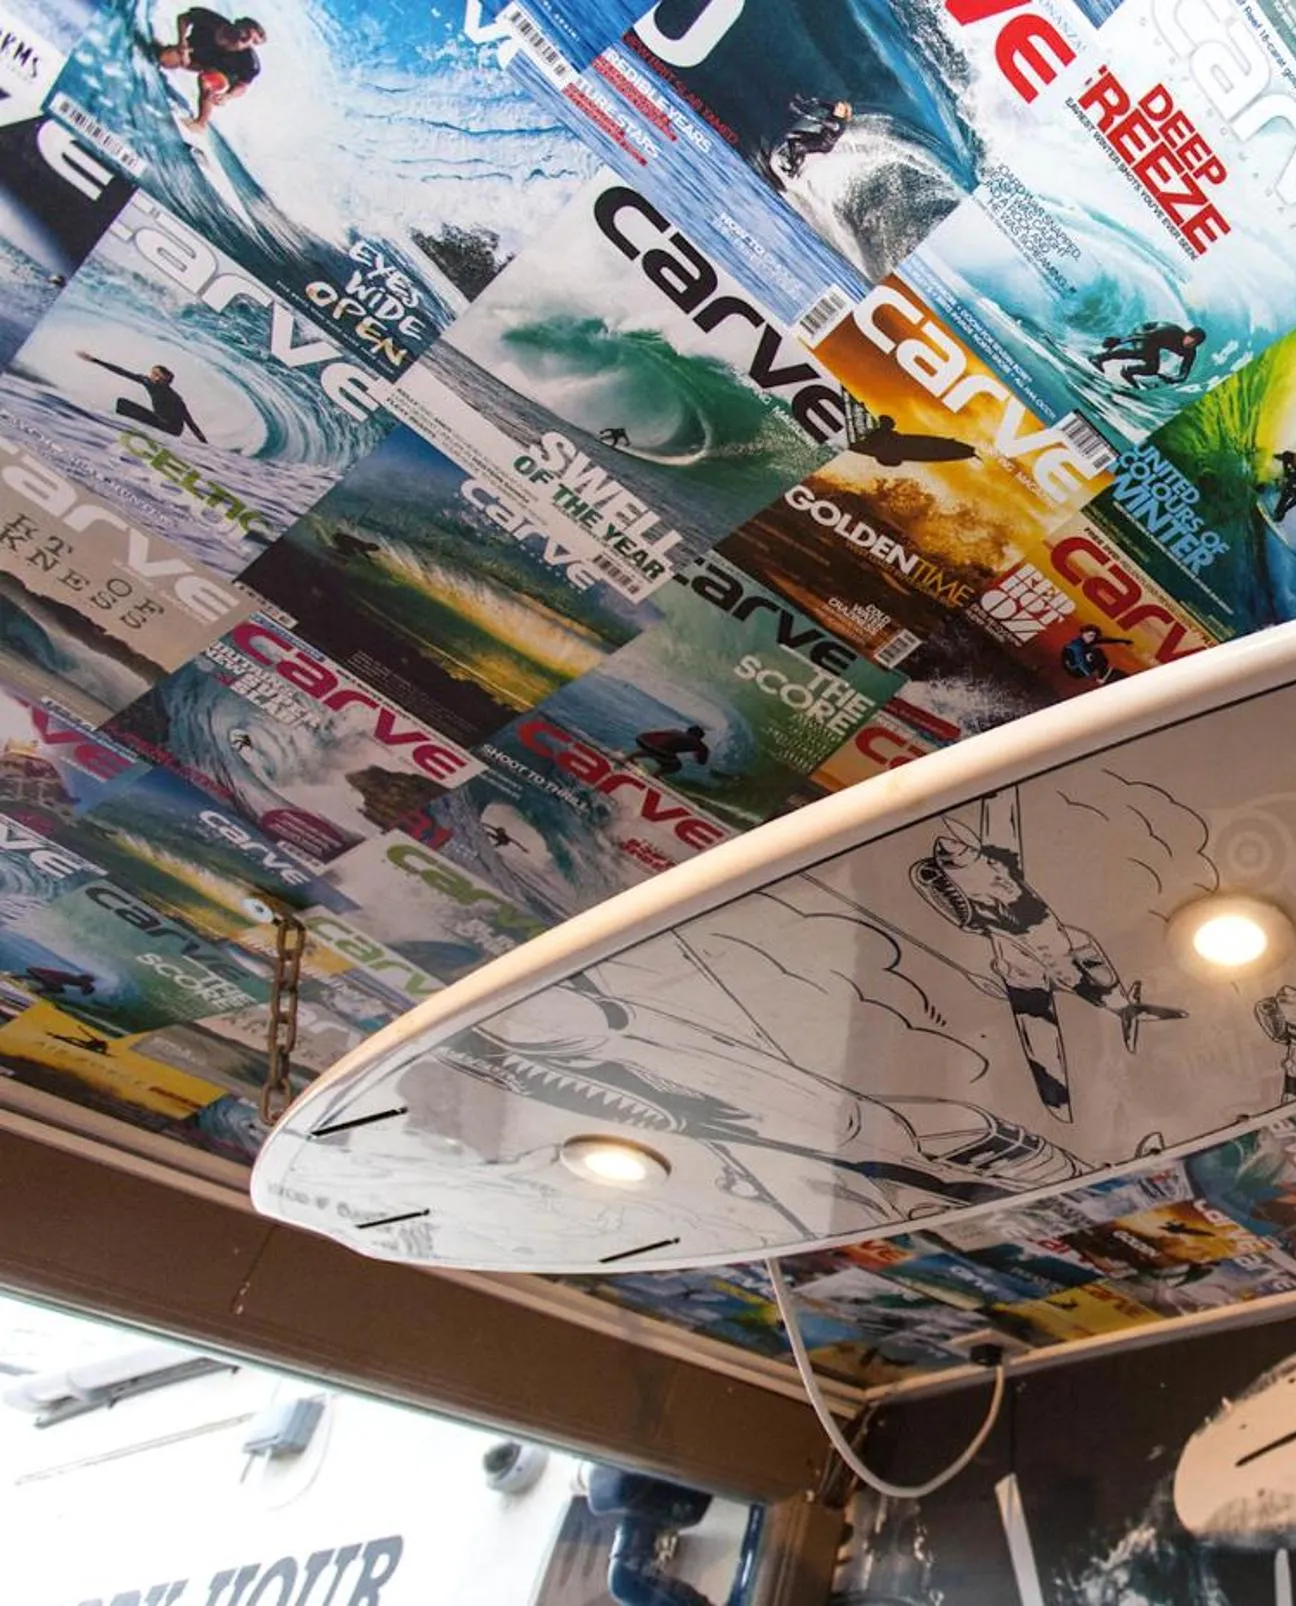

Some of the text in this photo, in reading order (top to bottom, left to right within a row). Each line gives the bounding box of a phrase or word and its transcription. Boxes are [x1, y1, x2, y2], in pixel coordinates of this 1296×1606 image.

[660, 102, 714, 155] YEARS
[1135, 82, 1231, 194] DEEP
[1091, 130, 1122, 166] WINTER
[1116, 162, 1143, 192] SHOTS
[1137, 189, 1165, 220] YOU'VE
[1159, 216, 1181, 240] EVER
[340, 268, 431, 347] WIDE
[346, 236, 427, 311] EYES
[300, 272, 412, 369] OPEN
[511, 451, 666, 581] OF THE YEAR
[523, 423, 689, 564] SWELL
[1094, 459, 1217, 577] WINTER
[1116, 448, 1205, 535] COLOURS
[1195, 526, 1230, 560] OF
[1131, 437, 1203, 506] UNITED
[726, 650, 855, 739] SCORE
[802, 665, 875, 722] THE
[481, 744, 526, 776] SHOOT
[525, 770, 546, 787] TO
